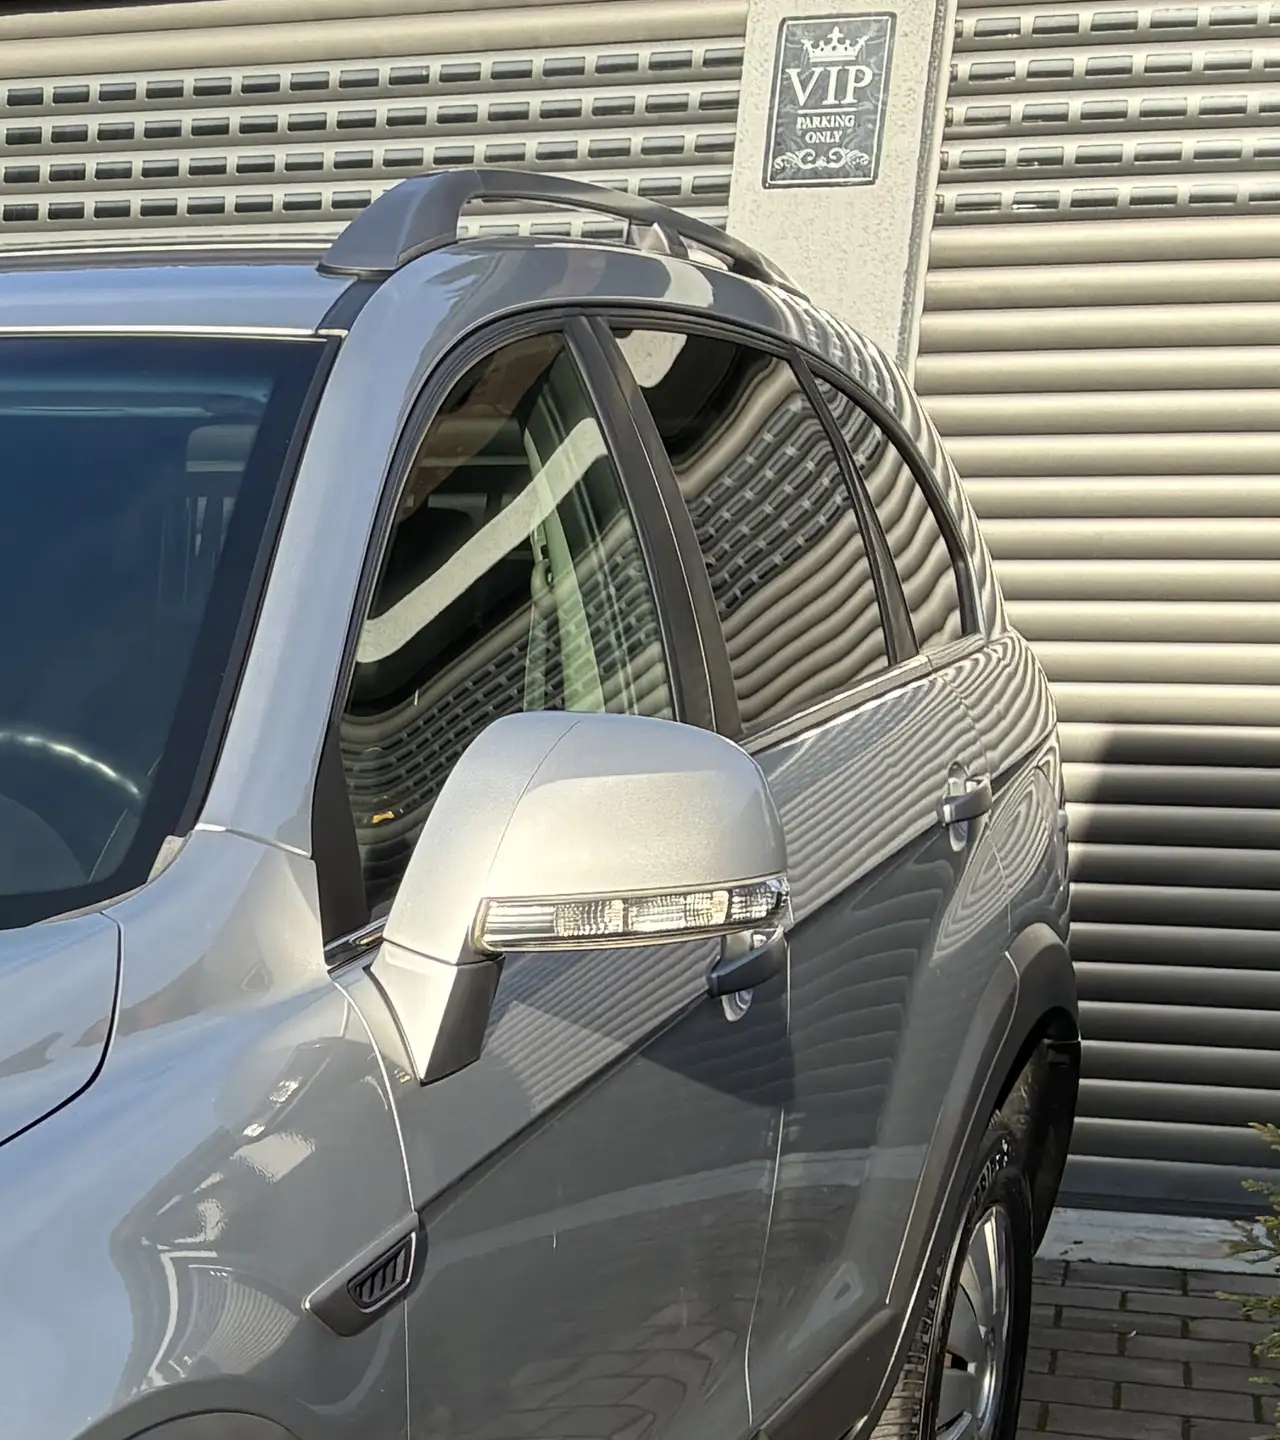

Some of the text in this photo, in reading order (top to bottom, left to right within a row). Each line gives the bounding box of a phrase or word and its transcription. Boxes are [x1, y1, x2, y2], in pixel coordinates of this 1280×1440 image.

[785, 65, 873, 107] VIP
[796, 115, 856, 130] PARKING
[805, 131, 843, 144] ONLY
